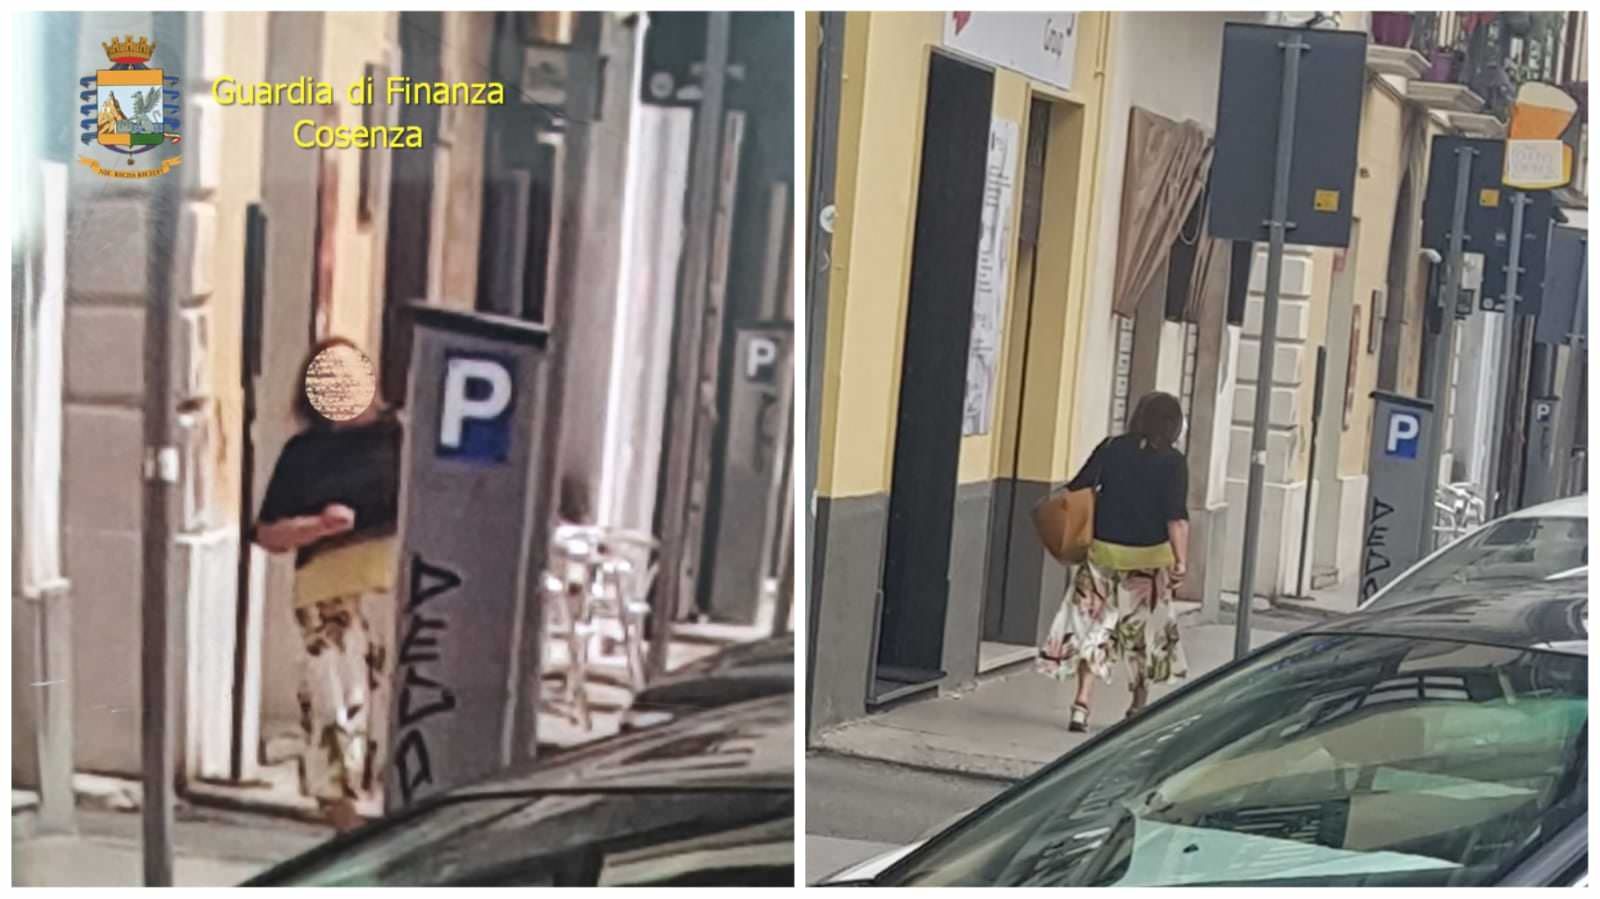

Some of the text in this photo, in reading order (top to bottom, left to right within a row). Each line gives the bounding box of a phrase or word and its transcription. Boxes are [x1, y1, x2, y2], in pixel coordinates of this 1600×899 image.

[746, 339, 777, 377] P
[440, 357, 512, 448] P
[1537, 403, 1550, 421] P
[1387, 413, 1419, 454] P
